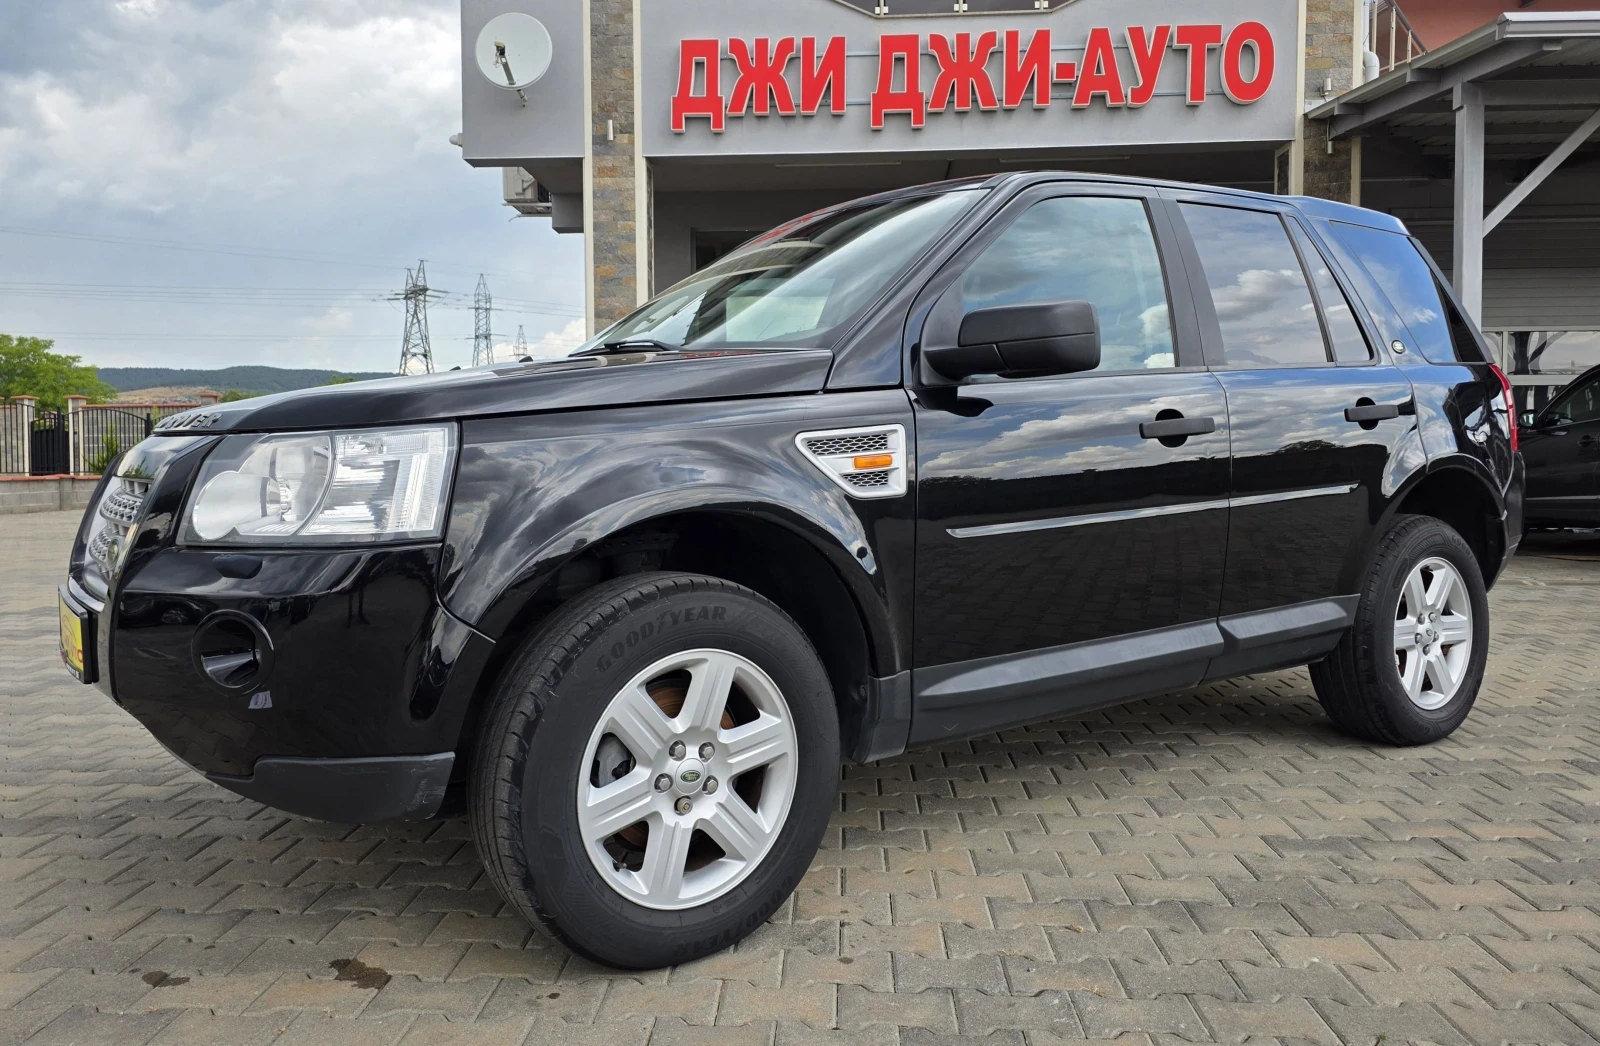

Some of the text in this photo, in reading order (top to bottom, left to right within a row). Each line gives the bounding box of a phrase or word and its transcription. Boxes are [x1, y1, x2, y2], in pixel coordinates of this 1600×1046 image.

[670, 21, 1276, 133] ДЖИ ДЖИ-АУТО
[596, 605, 727, 673] GOODYEAR
